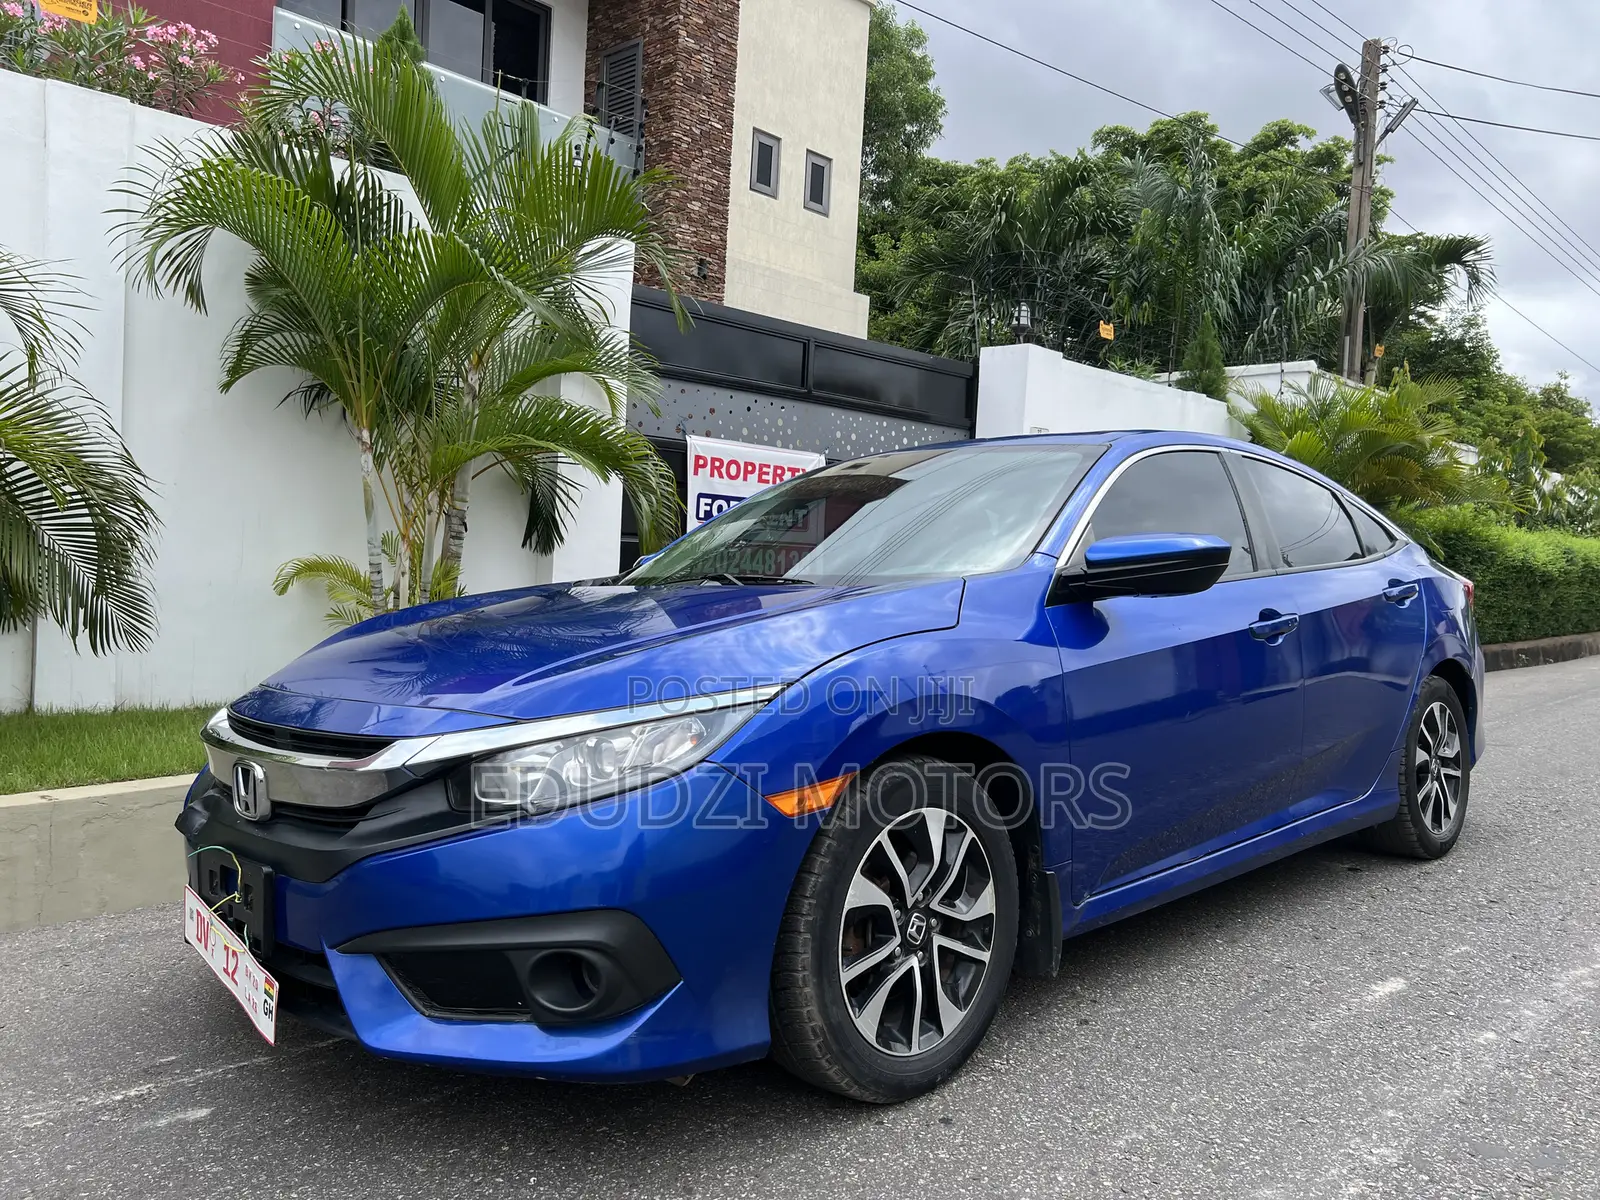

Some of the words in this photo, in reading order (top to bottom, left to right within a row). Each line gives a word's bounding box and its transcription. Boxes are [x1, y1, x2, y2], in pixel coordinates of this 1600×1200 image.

[693, 454, 807, 485] PROPERT
[195, 907, 210, 952] DV
[263, 998, 274, 1022] GH
